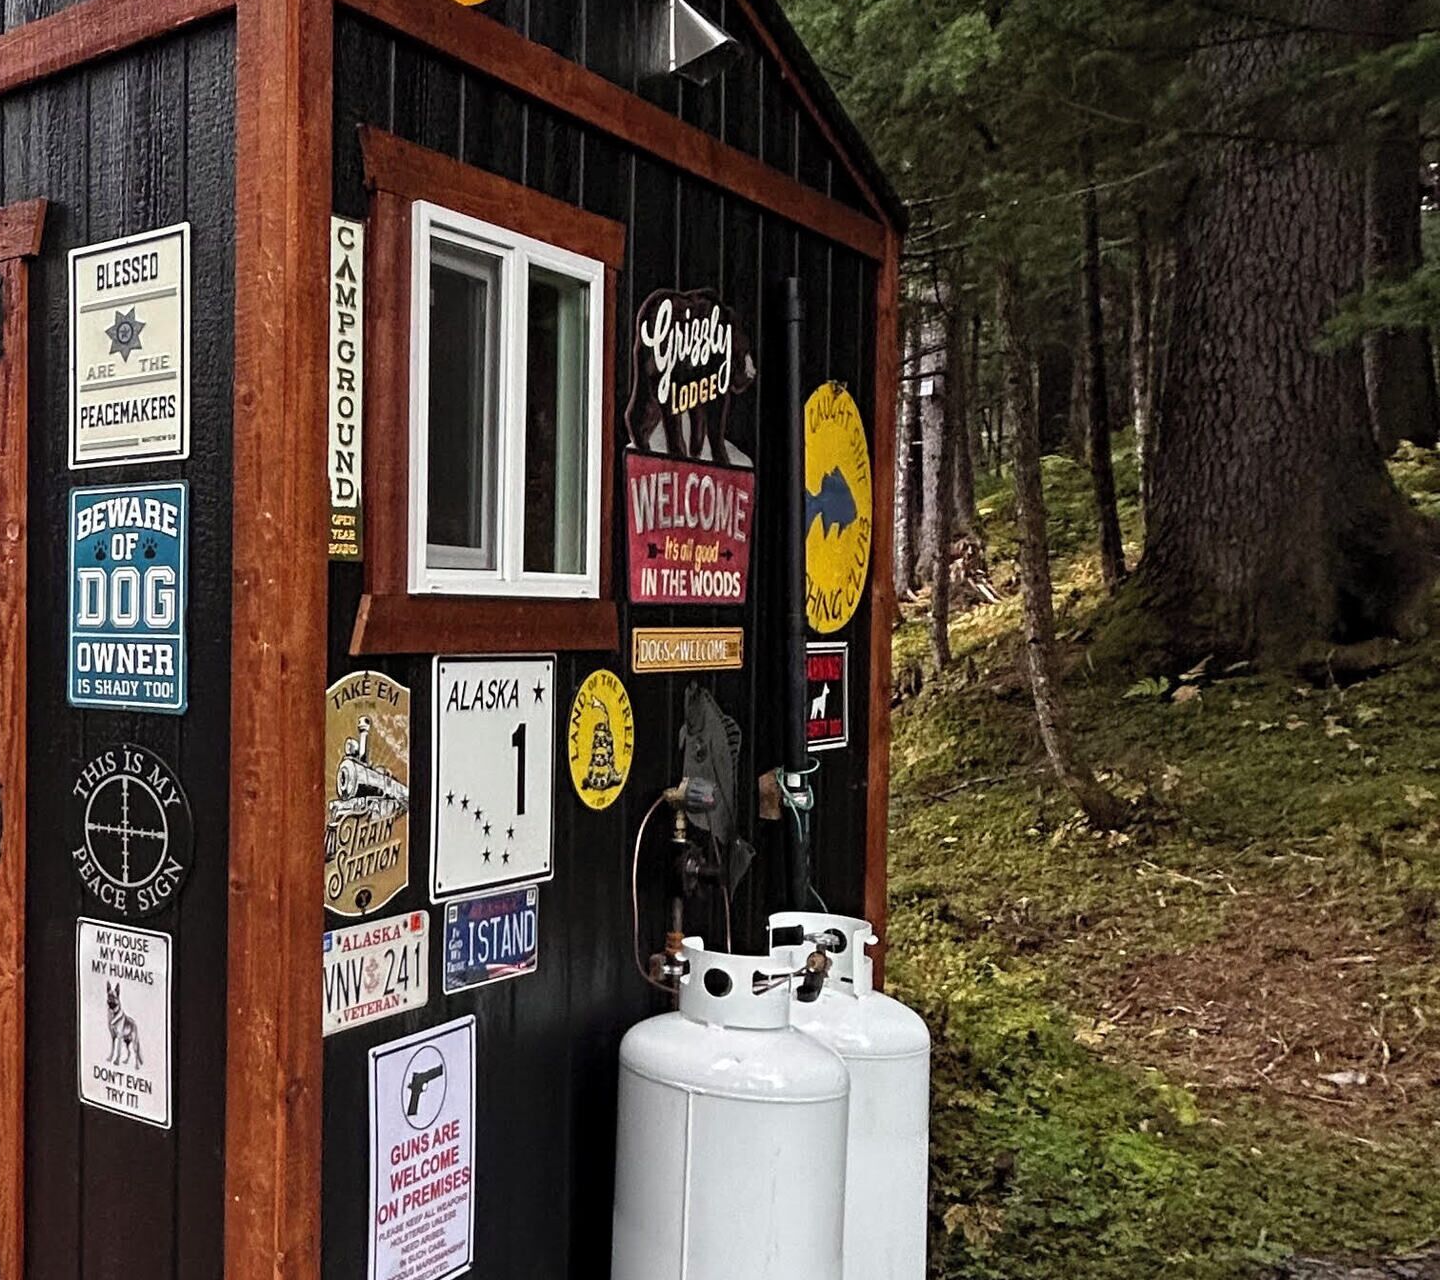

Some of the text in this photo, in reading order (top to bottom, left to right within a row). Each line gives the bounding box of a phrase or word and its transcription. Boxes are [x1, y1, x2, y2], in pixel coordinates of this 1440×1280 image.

[97, 252, 158, 291] BLESSED
[86, 355, 170, 381] ARE THE
[335, 226, 357, 501] CAMPGROUND
[641, 299, 732, 404] Grizzly
[672, 373, 718, 415] LODGE
[80, 395, 176, 429] PEACEMAKERS
[810, 396, 853, 434] CAUGHT
[77, 497, 178, 541] BEWARE
[332, 514, 356, 526] OPEN
[631, 472, 749, 542] WELCOME
[111, 533, 139, 560] OF
[328, 542, 358, 555] ROUND
[332, 529, 356, 540] YEAR
[694, 539, 720, 571] good
[77, 566, 176, 629] DOG
[641, 568, 741, 597] IN THE WOODS
[77, 642, 174, 676] OWNER
[639, 639, 728, 663] DOGS WELCOME
[78, 679, 174, 698] IS SHADY TOO!
[331, 679, 370, 710] TAKE
[446, 679, 519, 712] ALASKA
[571, 674, 633, 761] LAND OF THE FREE
[73, 751, 180, 807] THIS IS MY
[512, 723, 526, 816] 1
[72, 845, 183, 911] PEACE SIGN
[96, 930, 149, 953] MY HOUSE
[342, 925, 402, 953] ALASKA
[92, 960, 154, 985] MY HUMANS
[100, 946, 145, 967] MY YARD
[324, 942, 421, 1014] VNV 241
[343, 994, 401, 1023] VETERAN
[93, 1065, 152, 1094] DON'T EVEN
[106, 1086, 124, 1103] TRY
[390, 1119, 460, 1166] GUNS ARE
[390, 1145, 459, 1193] WELCOME
[378, 1166, 471, 1225] ON PREMISES
[379, 1192, 467, 1242] PLEASE KEEP ALL WEAPONS
[390, 1209, 456, 1248] HOLSTERED UNLESS
[400, 1259, 406, 1268] IN
[408, 1248, 427, 1263] SUCH
[401, 1239, 420, 1255] NEED
[416, 1239, 466, 1271] MARKSMANSHIP
